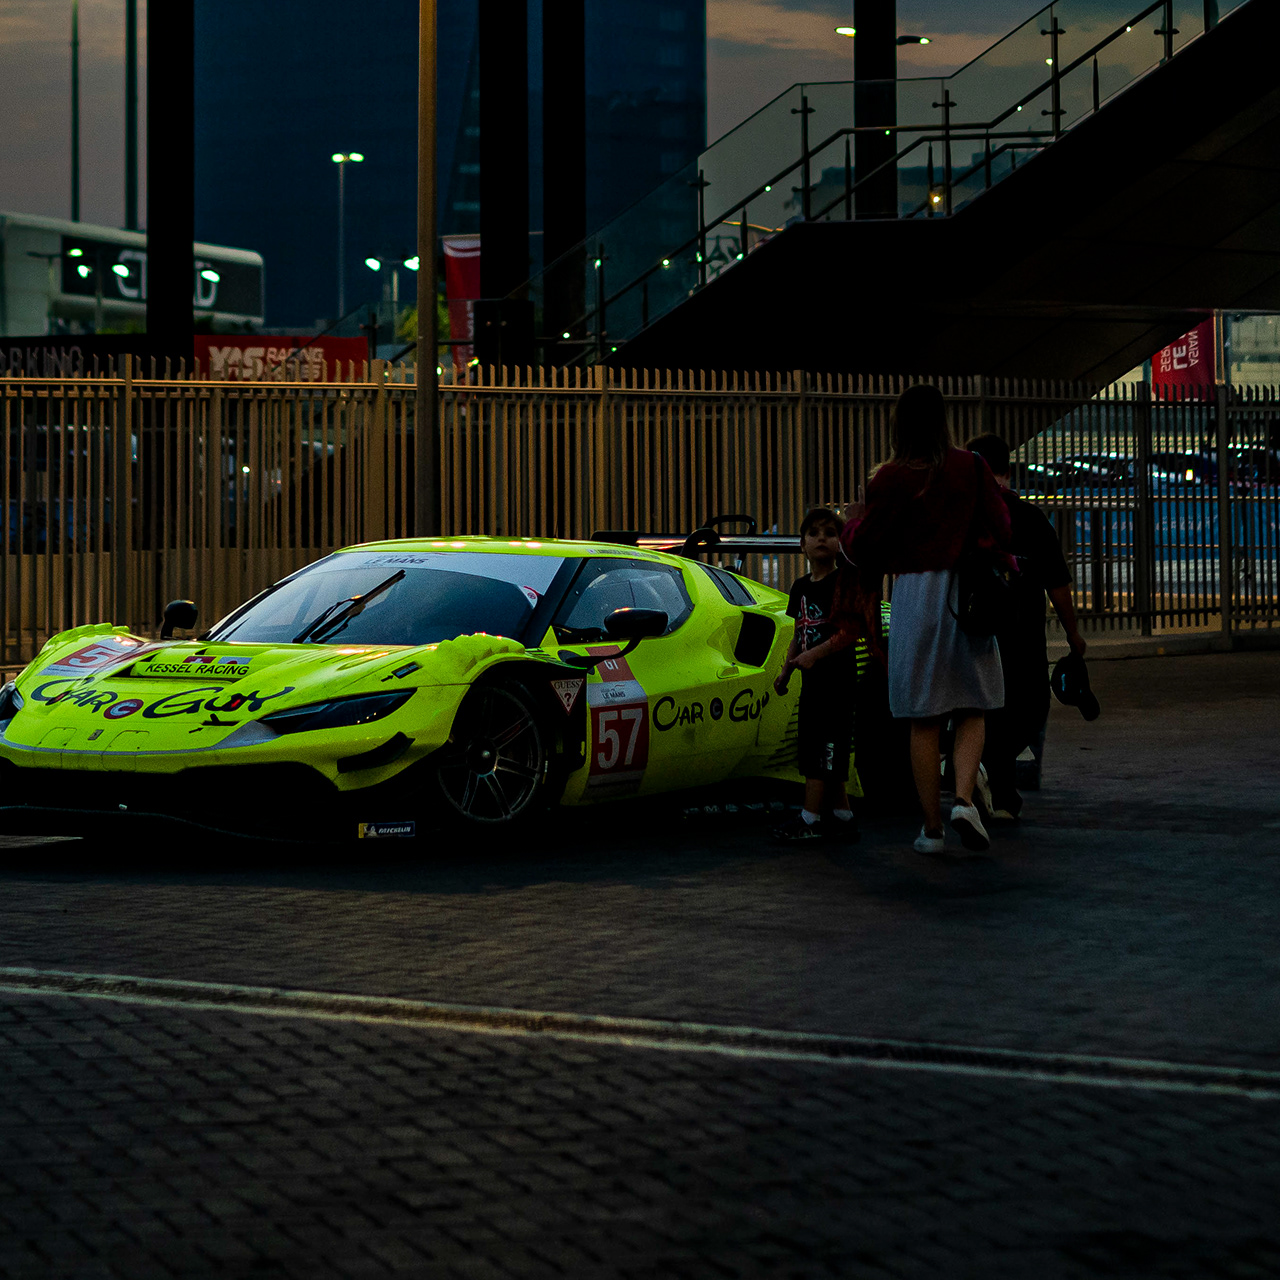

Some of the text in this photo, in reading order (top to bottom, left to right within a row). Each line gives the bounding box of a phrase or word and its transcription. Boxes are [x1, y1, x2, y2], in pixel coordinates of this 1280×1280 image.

[208, 345, 266, 379] YAS
[266, 346, 324, 362] RACING
[384, 557, 429, 565] MANS
[145, 663, 249, 676] KESSEL RACING
[553, 678, 583, 689] GUESS
[653, 696, 704, 731] CAR
[597, 708, 644, 770] 57
